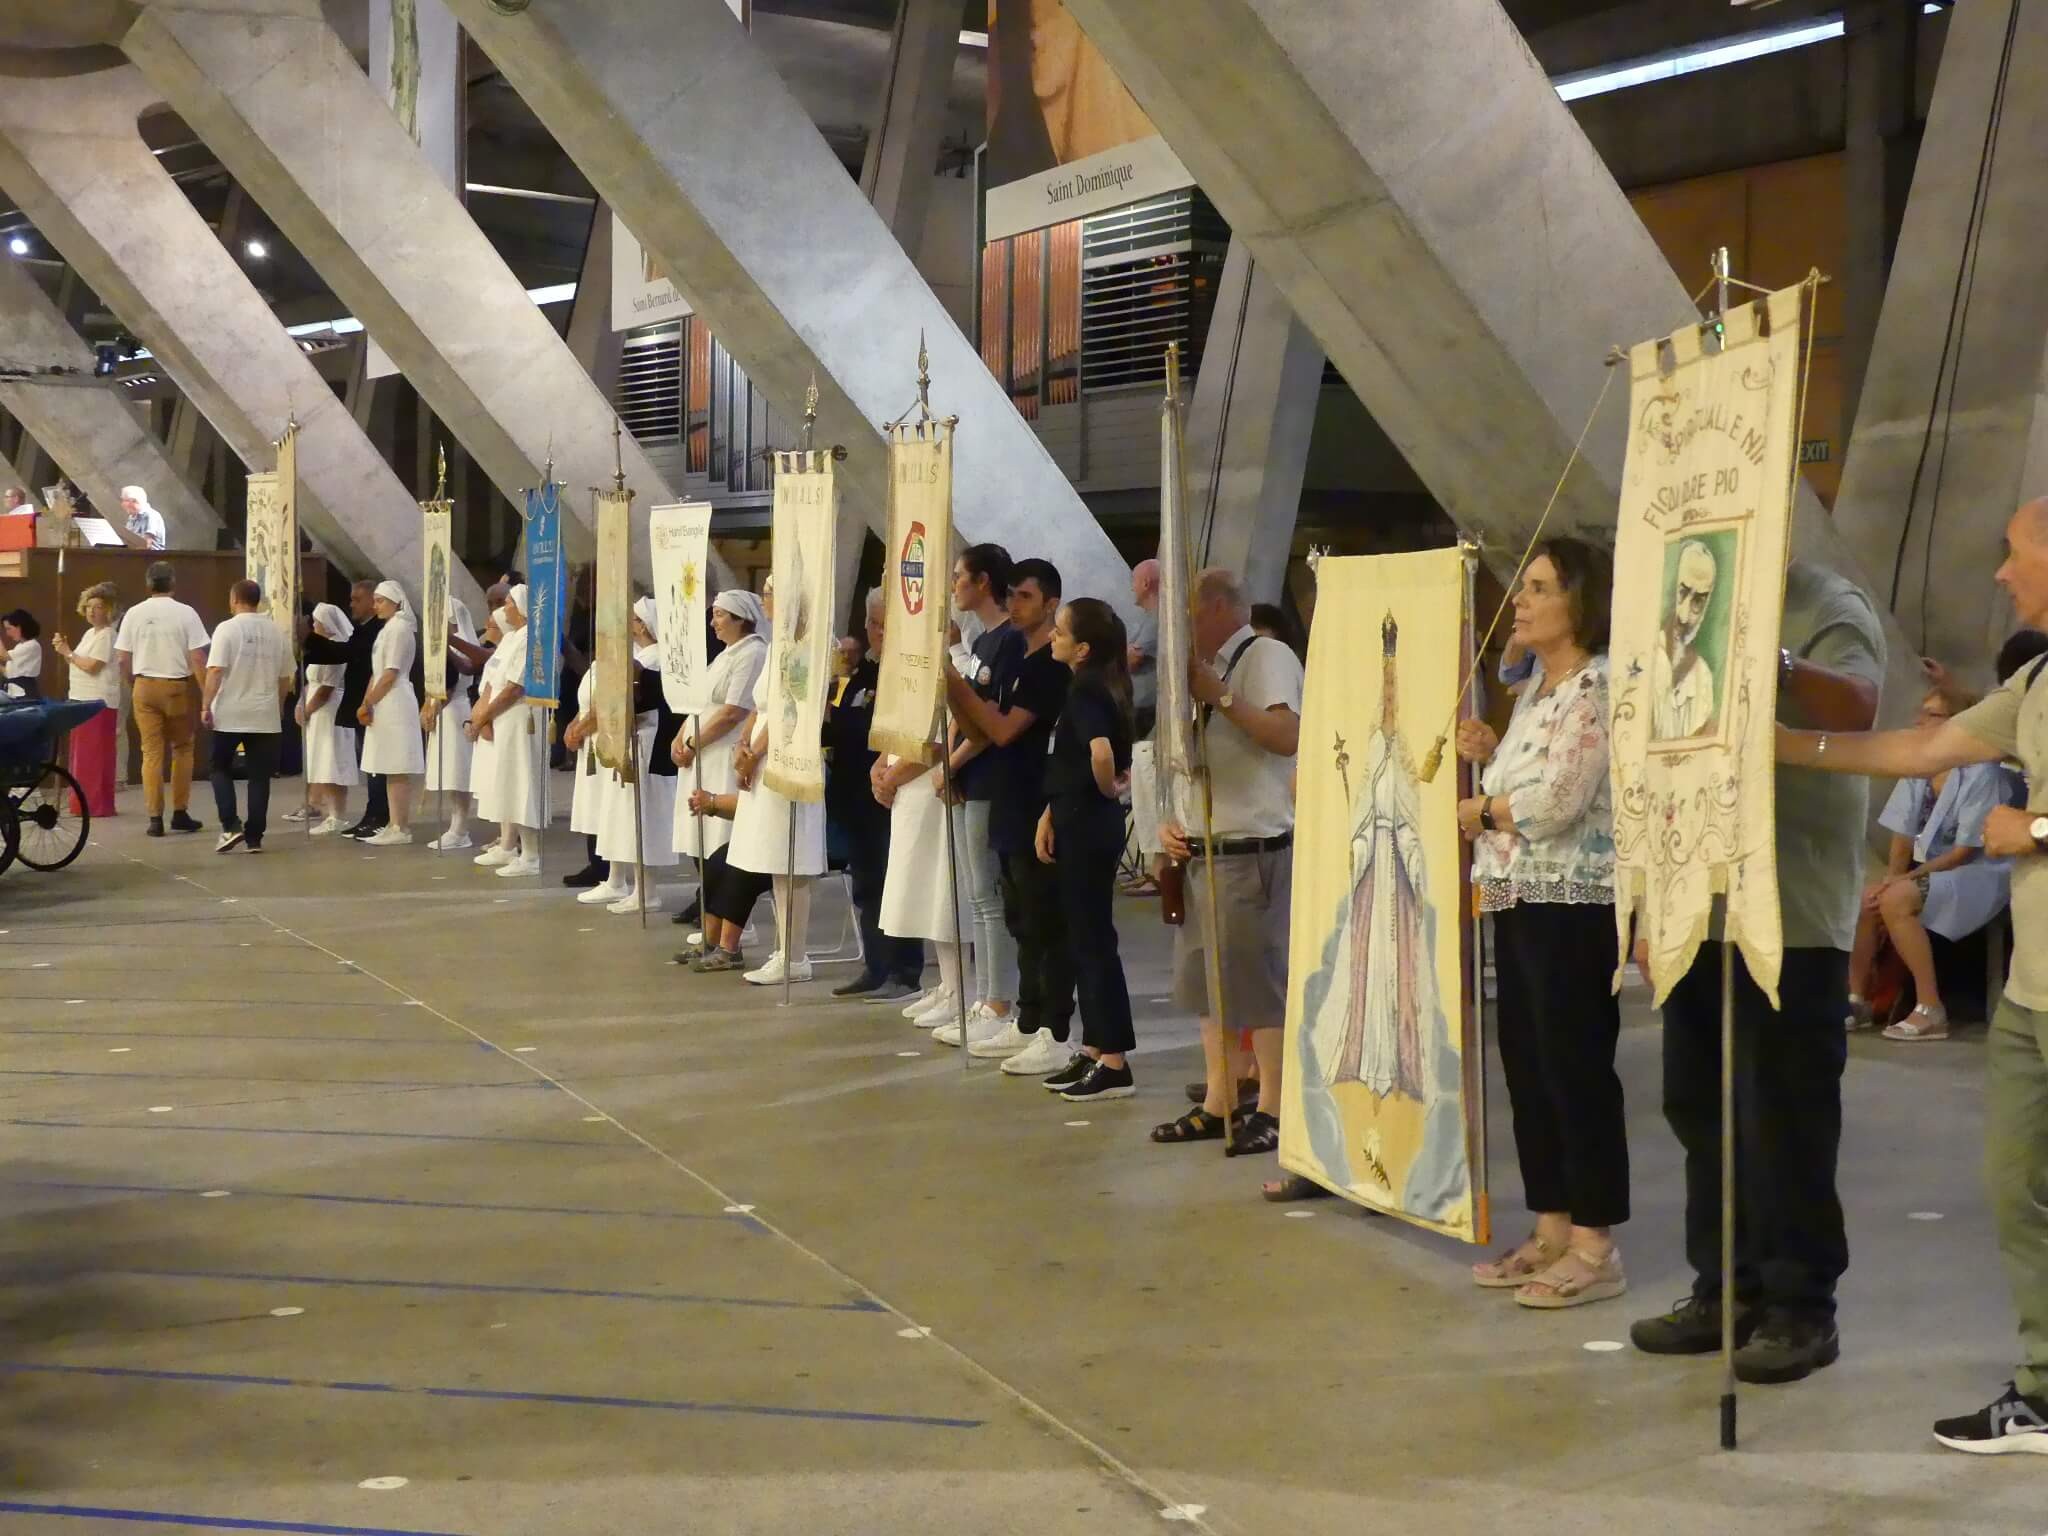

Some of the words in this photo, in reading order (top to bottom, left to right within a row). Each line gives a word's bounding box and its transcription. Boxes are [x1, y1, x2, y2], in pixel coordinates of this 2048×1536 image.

[1047, 180, 1074, 205] Saint
[1075, 163, 1134, 196] Dominique
[647, 287, 672, 309] Bernard
[1713, 466, 1739, 497] PIO
